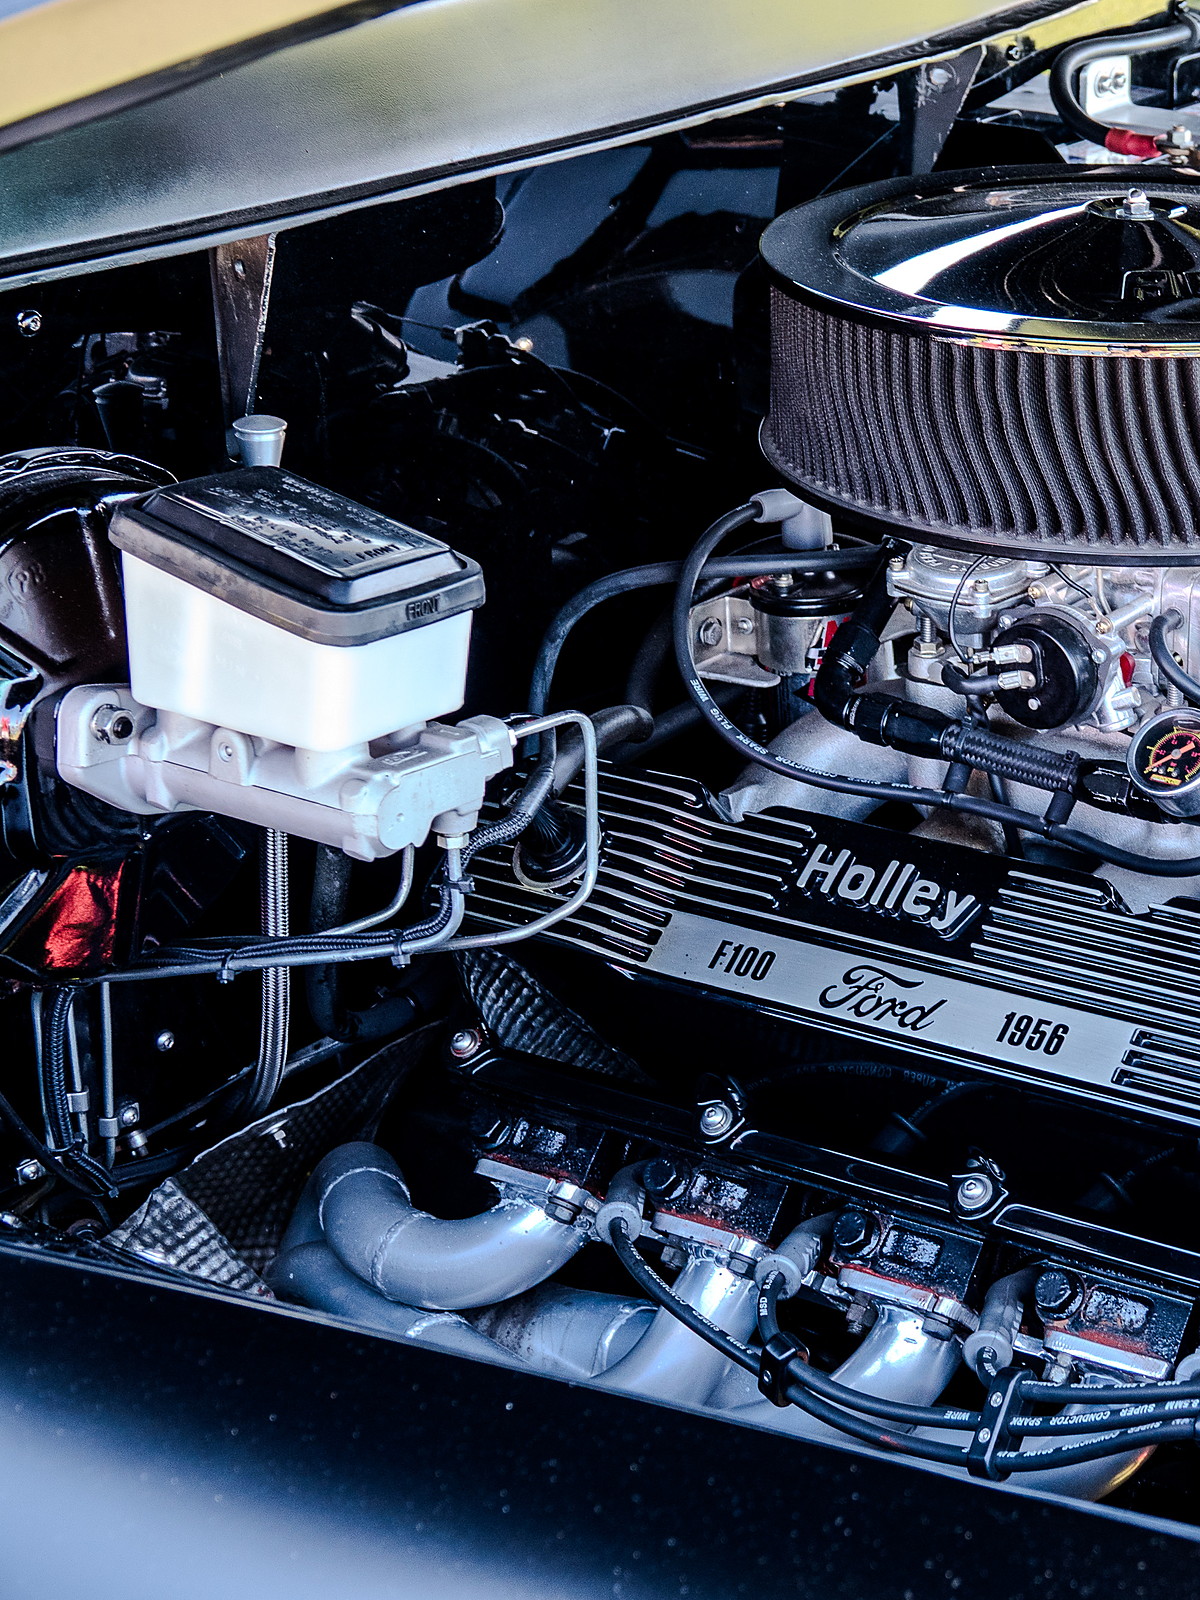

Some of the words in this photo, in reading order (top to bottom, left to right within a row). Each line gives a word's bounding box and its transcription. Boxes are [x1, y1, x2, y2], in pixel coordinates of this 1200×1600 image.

[405, 594, 441, 621] FRONT
[689, 678, 709, 703] WIRE
[709, 708, 733, 731] PLUG
[736, 734, 769, 755] SPARK
[796, 842, 978, 932] Holley
[707, 939, 777, 982] F100
[818, 964, 949, 1032] Ford
[995, 1011, 1070, 1057] 1956
[760, 1297, 768, 1316] MSD
[944, 1410, 971, 1422] WIRE
[1119, 1403, 1157, 1418] SUPER
[1164, 1399, 1200, 1411] 8.5MM
[1010, 1417, 1043, 1427] SPARK
[1049, 1410, 1111, 1426] CONDUCTOR
